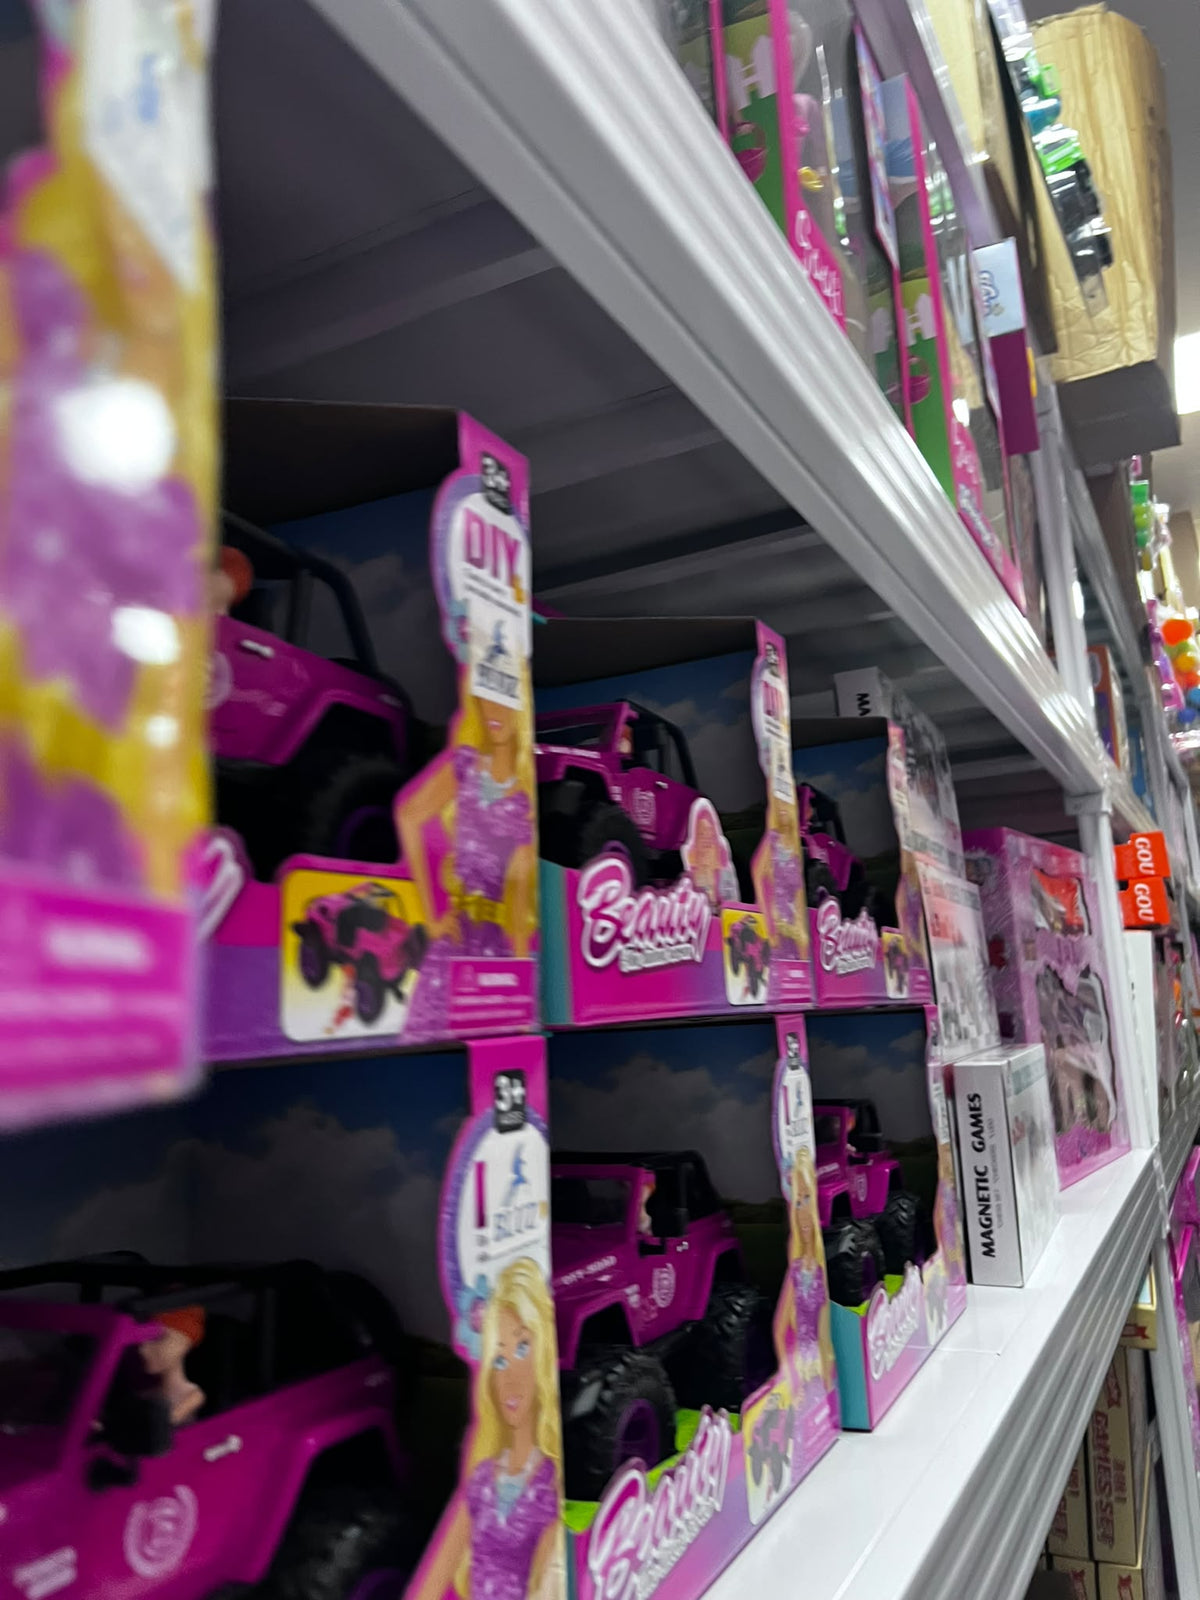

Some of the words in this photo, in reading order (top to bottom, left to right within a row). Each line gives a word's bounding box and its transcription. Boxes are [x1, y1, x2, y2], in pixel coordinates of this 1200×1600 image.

[464, 508, 521, 588] DIY
[1135, 837, 1155, 875] GOU
[578, 858, 712, 966] Beauty
[1134, 883, 1155, 922] GOU
[495, 1074, 526, 1112] 3+
[967, 1092, 986, 1153] GAMES
[973, 1165, 996, 1258] MAGNETIC
